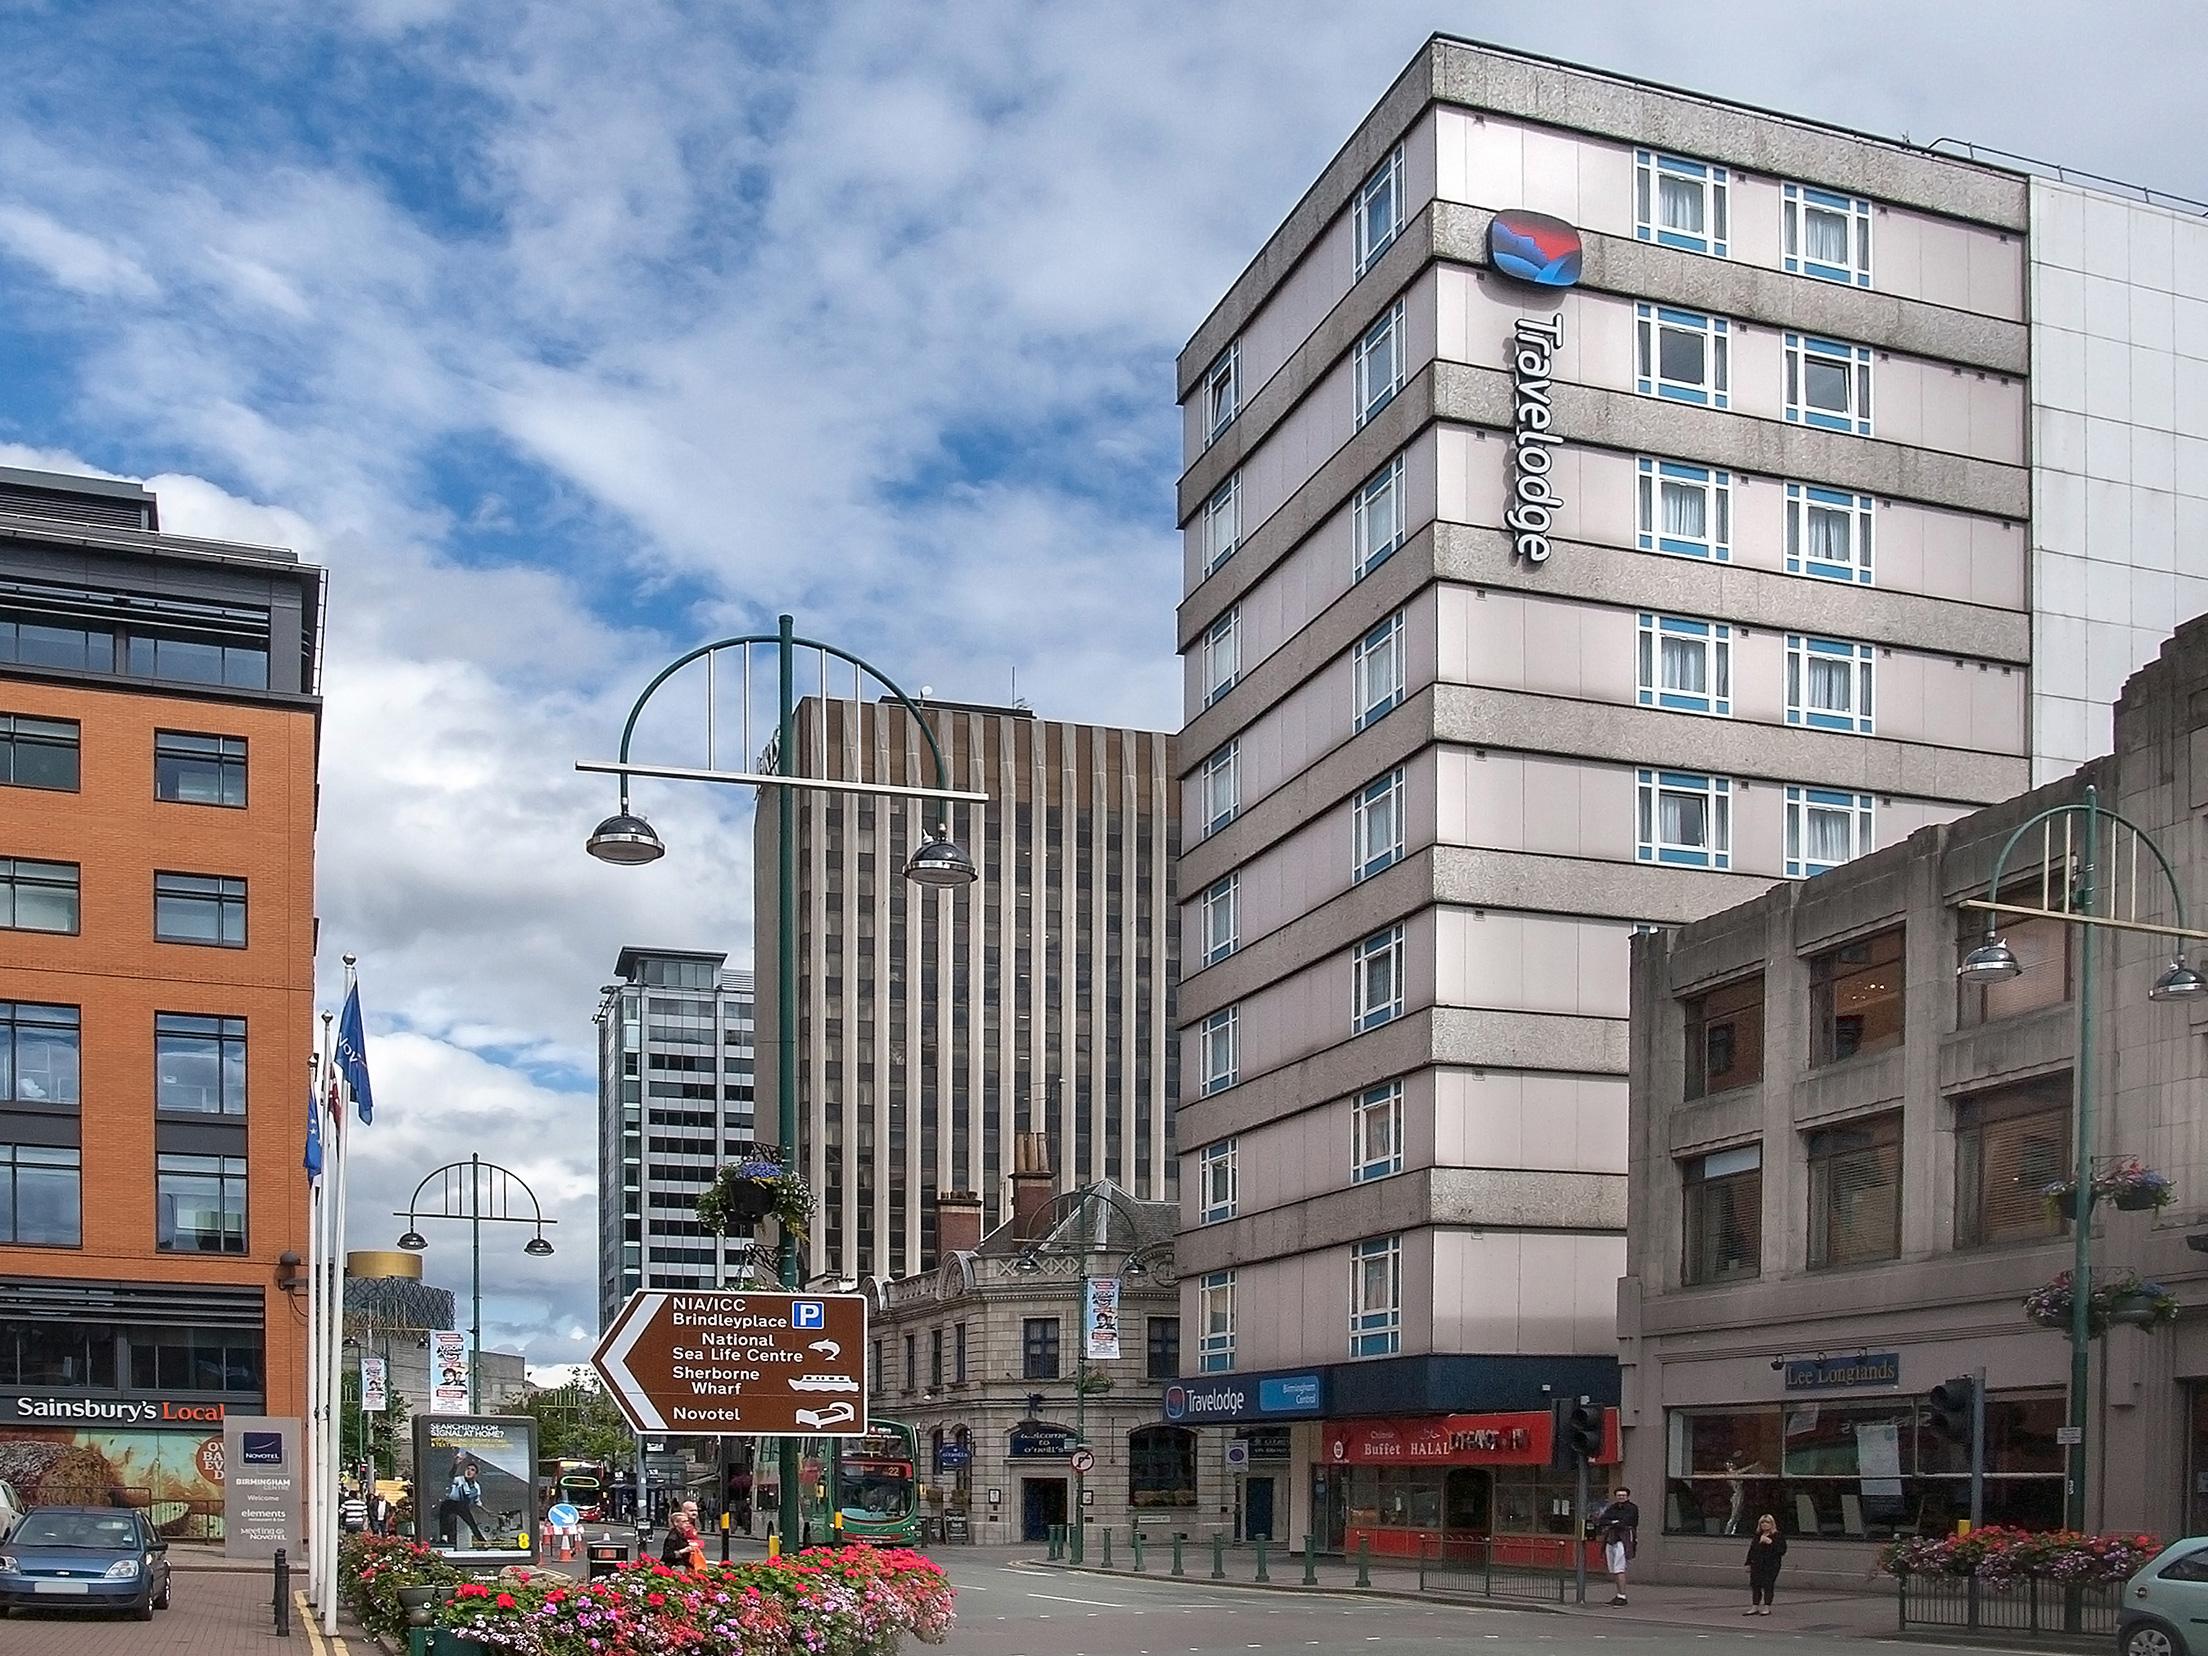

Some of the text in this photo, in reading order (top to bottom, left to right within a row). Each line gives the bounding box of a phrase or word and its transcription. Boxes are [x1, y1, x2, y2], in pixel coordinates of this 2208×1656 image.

[1504, 313, 1564, 563] Travelodge
[672, 1296, 746, 1312] NIA/ICC
[673, 1313, 787, 1329] Brindleyplace
[800, 1304, 819, 1326] P
[702, 1333, 775, 1347] National
[672, 1347, 803, 1362] Sea Life Centre
[672, 1366, 760, 1380] Sherborne
[1787, 1360, 1895, 1385] Lee Longlands
[691, 1382, 742, 1395] Wharf
[1186, 1387, 1244, 1415] Travelodge
[17, 1397, 224, 1422] Sainsbury's Local
[673, 1407, 741, 1421] Novotel
[475, 1430, 504, 1438] HOME?
[1364, 1442, 1450, 1455] Buffet HALAL
[235, 1478, 291, 1486] BIRMINGHAM
[241, 1509, 286, 1518] elements
